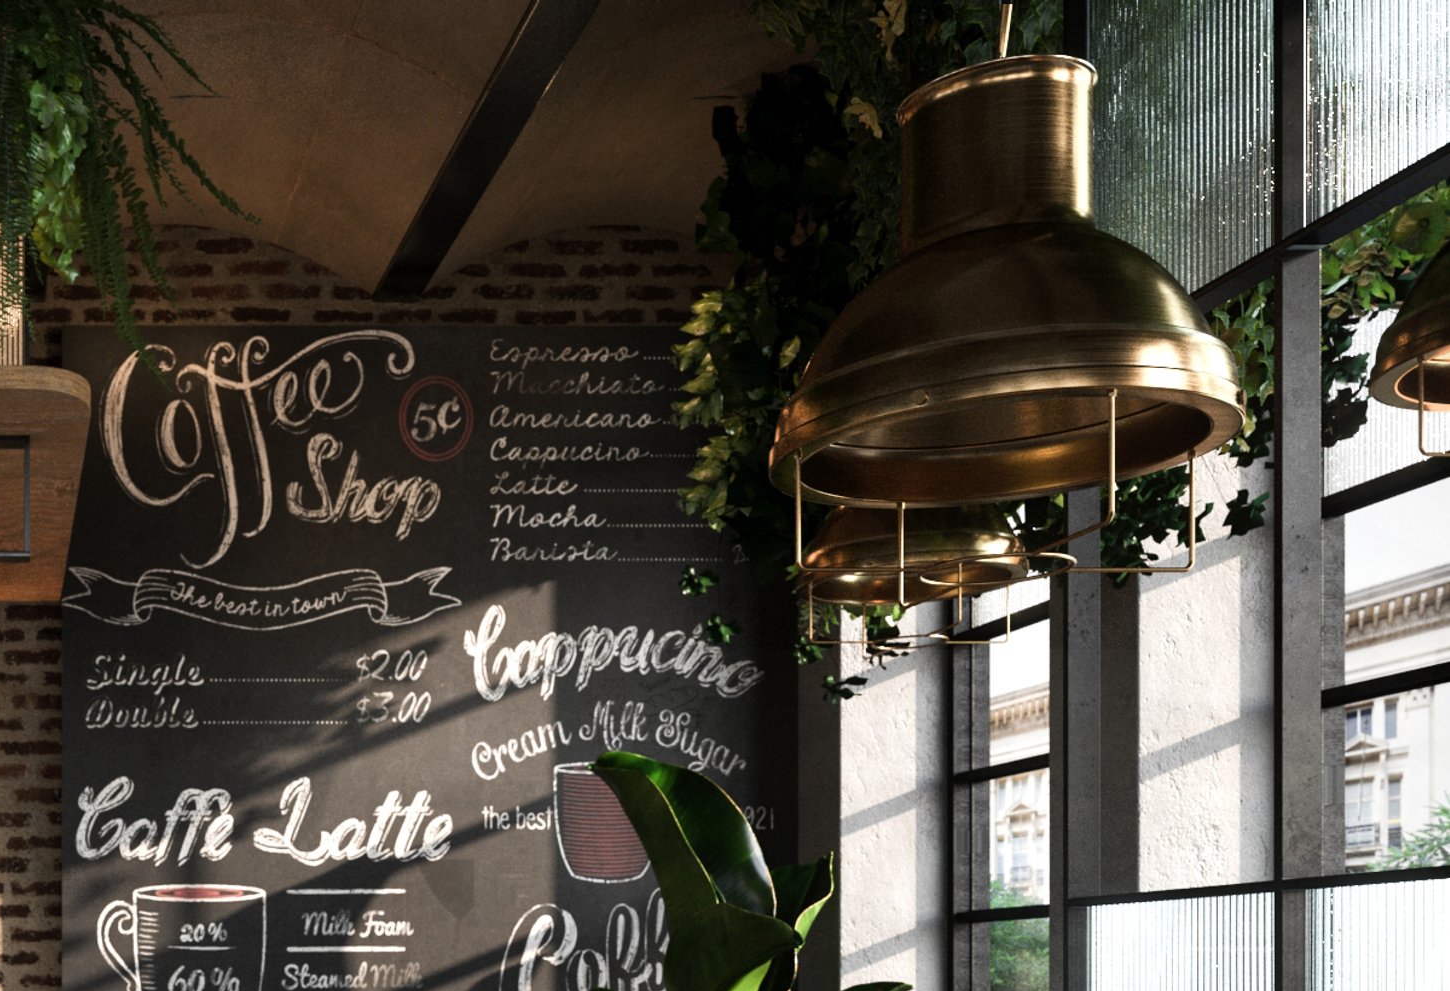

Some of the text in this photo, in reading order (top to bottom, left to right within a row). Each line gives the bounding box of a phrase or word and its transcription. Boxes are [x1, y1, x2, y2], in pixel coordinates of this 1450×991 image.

[489, 338, 639, 370] Espresso
[489, 370, 664, 395] Macchiato
[489, 404, 661, 429] Americano
[99, 328, 416, 569] Coffee
[489, 436, 650, 469] Cappucino
[285, 431, 442, 542] Shop
[489, 471, 578, 495] Latte
[489, 504, 606, 528] Mocha
[489, 537, 618, 562] Barista
[170, 582, 347, 617] The best in town
[463, 602, 766, 702] Cappucino
[86, 649, 429, 696] Single $2.00
[85, 691, 432, 729] Double $3.00
[470, 700, 747, 781] Cream Milk Sugar
[252, 775, 455, 867] Latte
[481, 803, 512, 831] the
[516, 804, 553, 831] best
[179, 922, 228, 943] 20%
[301, 910, 415, 938] Milk Foam
[281, 961, 425, 991] Steamed Milk
